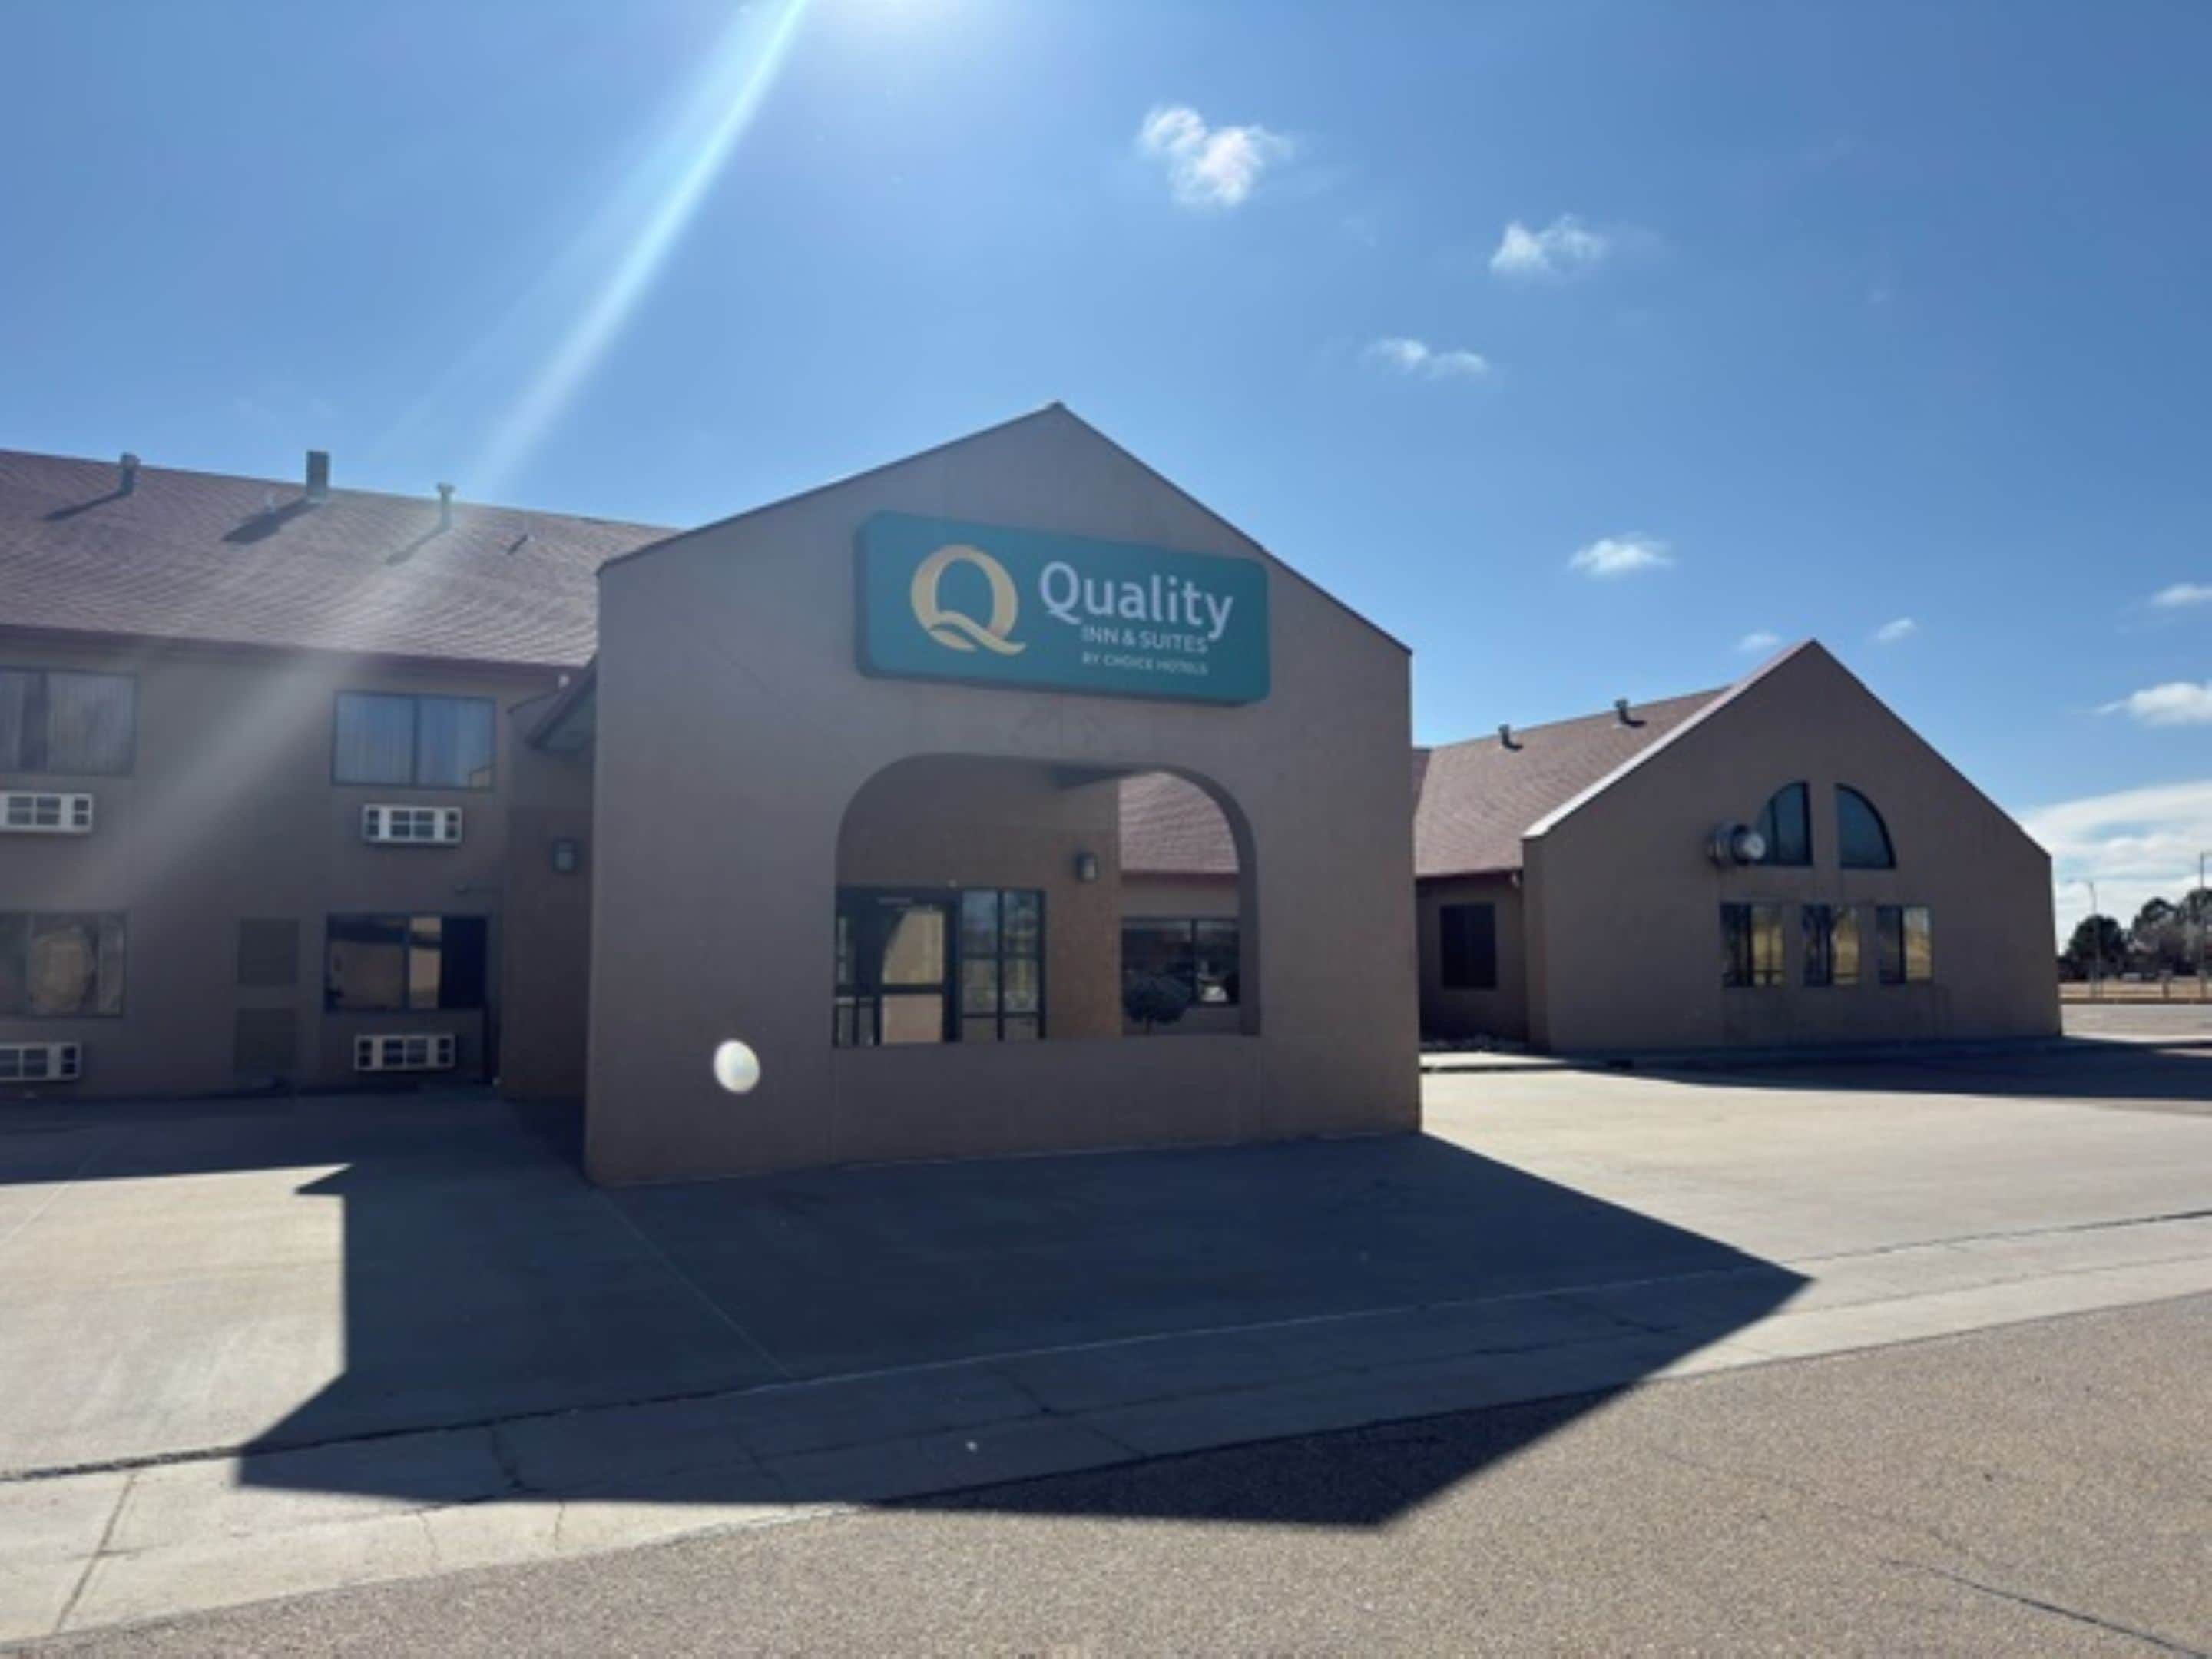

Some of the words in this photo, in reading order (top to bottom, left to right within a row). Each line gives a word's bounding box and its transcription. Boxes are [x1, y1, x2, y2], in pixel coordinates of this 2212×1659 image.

[910, 543, 1026, 655] Q
[1039, 561, 1233, 640] Quality
[1081, 626, 1119, 645] INN
[1121, 629, 1137, 647] &
[1138, 631, 1208, 653] SUITES
[1082, 652, 1101, 664] BY
[1104, 654, 1153, 670] CHOICE
